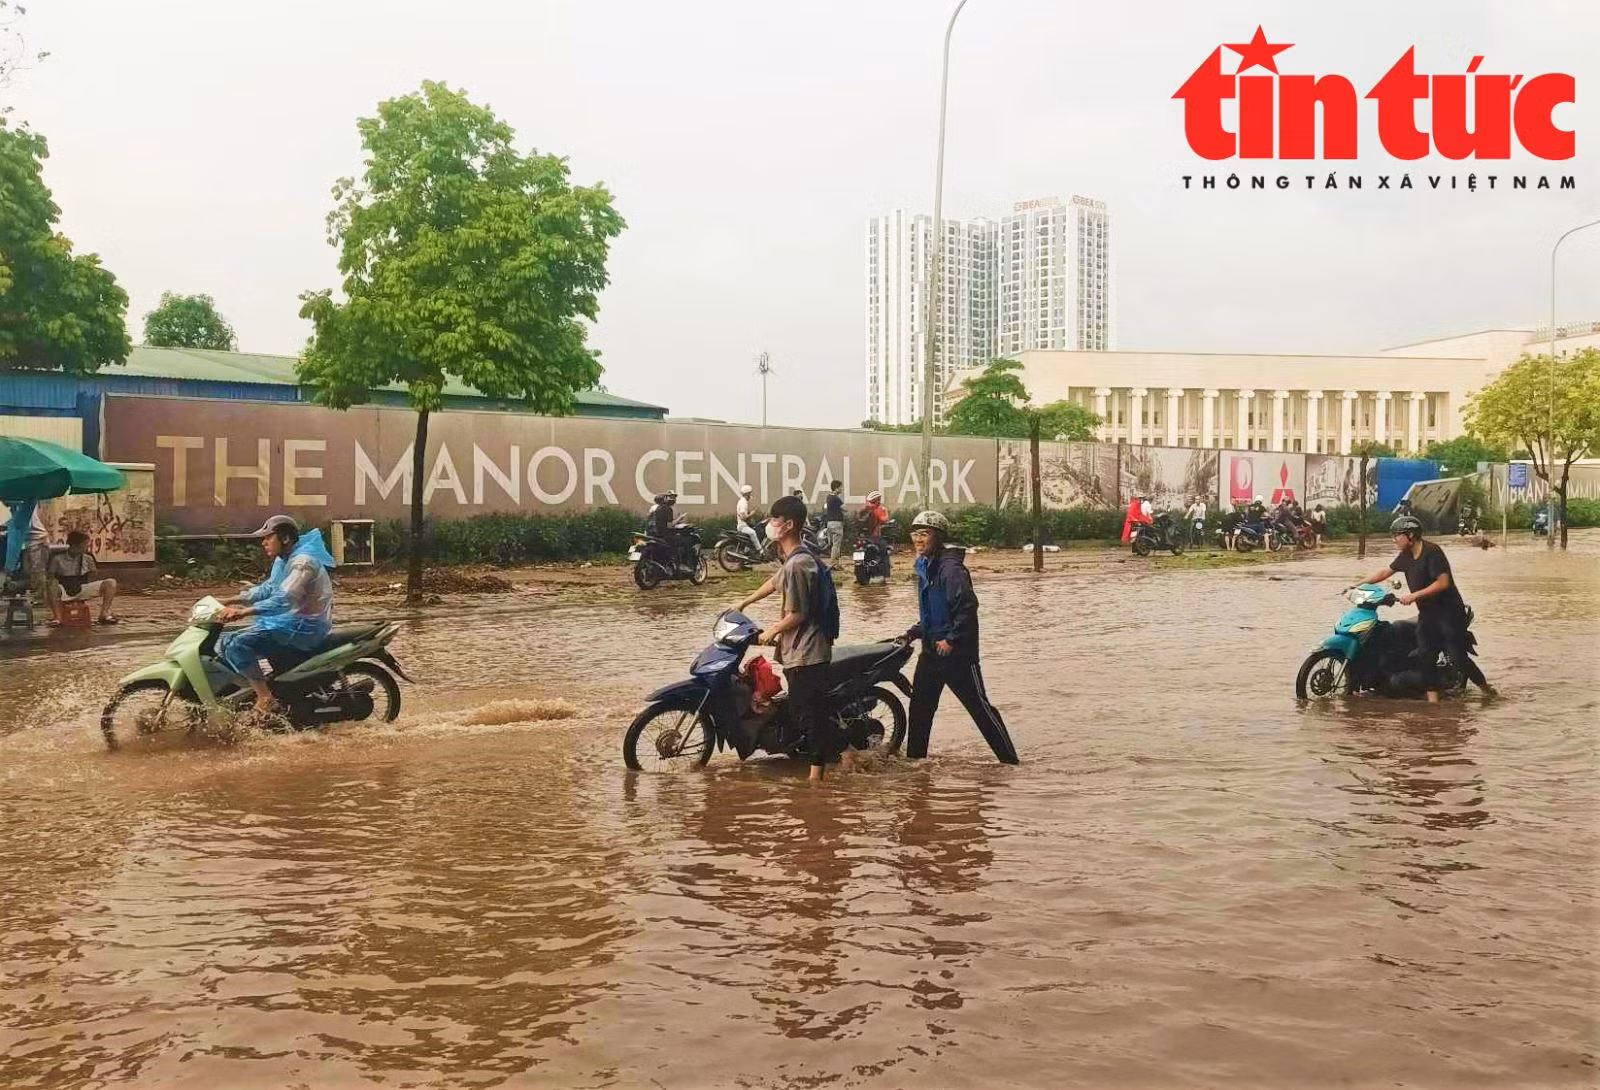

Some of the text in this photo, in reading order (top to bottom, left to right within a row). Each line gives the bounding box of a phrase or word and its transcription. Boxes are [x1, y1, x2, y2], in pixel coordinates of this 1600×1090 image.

[156, 435, 977, 507] THE MANOR CENTRAL PARK
